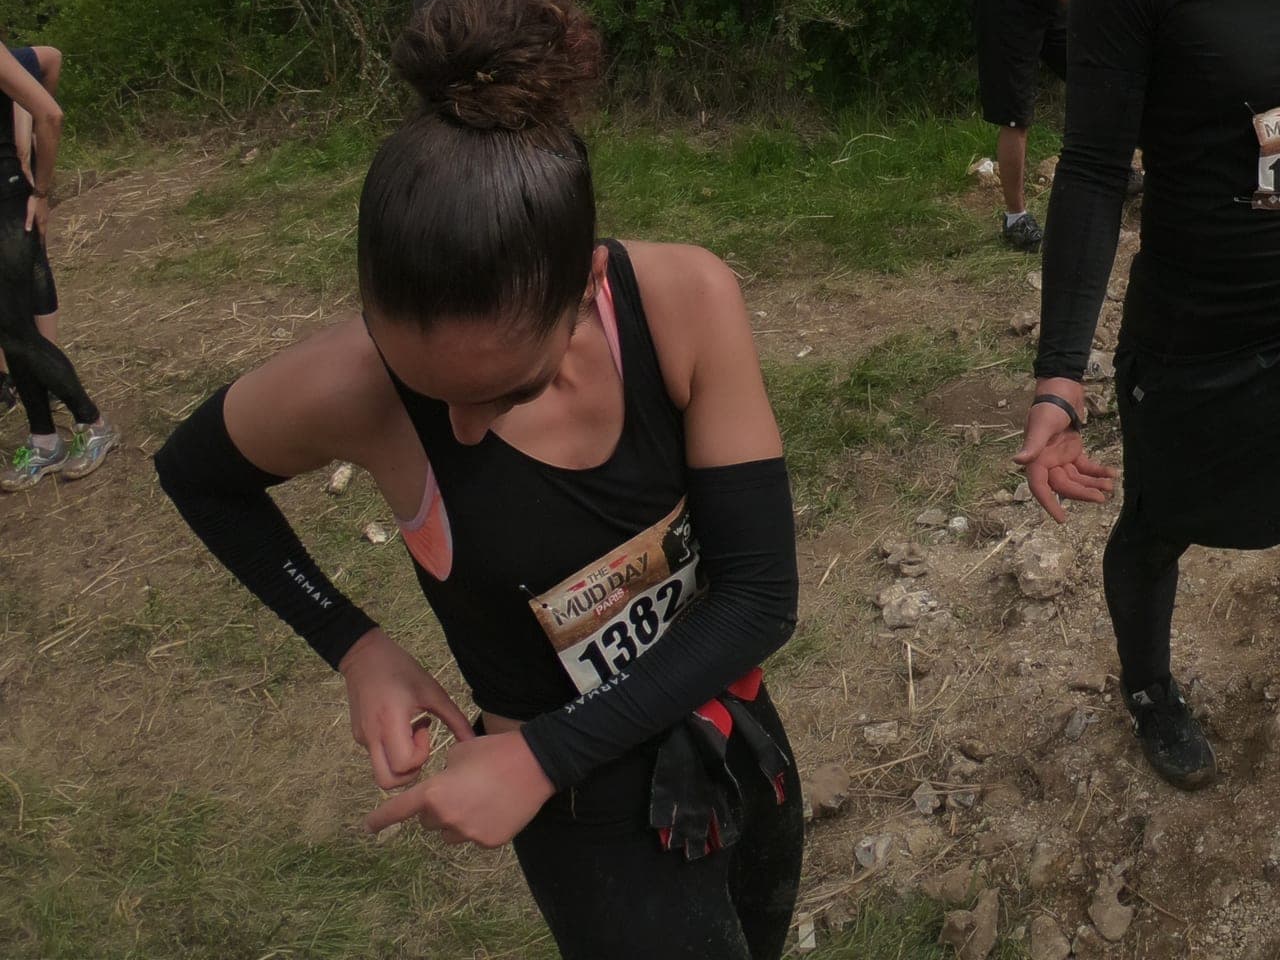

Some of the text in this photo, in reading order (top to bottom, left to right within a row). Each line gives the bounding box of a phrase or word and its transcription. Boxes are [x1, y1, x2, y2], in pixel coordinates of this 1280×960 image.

[283, 560, 333, 608] TARMAK
[552, 552, 649, 627] MUD DAY
[586, 565, 609, 583] THE
[594, 588, 625, 616] PARIS
[565, 672, 630, 714] TARMAK
